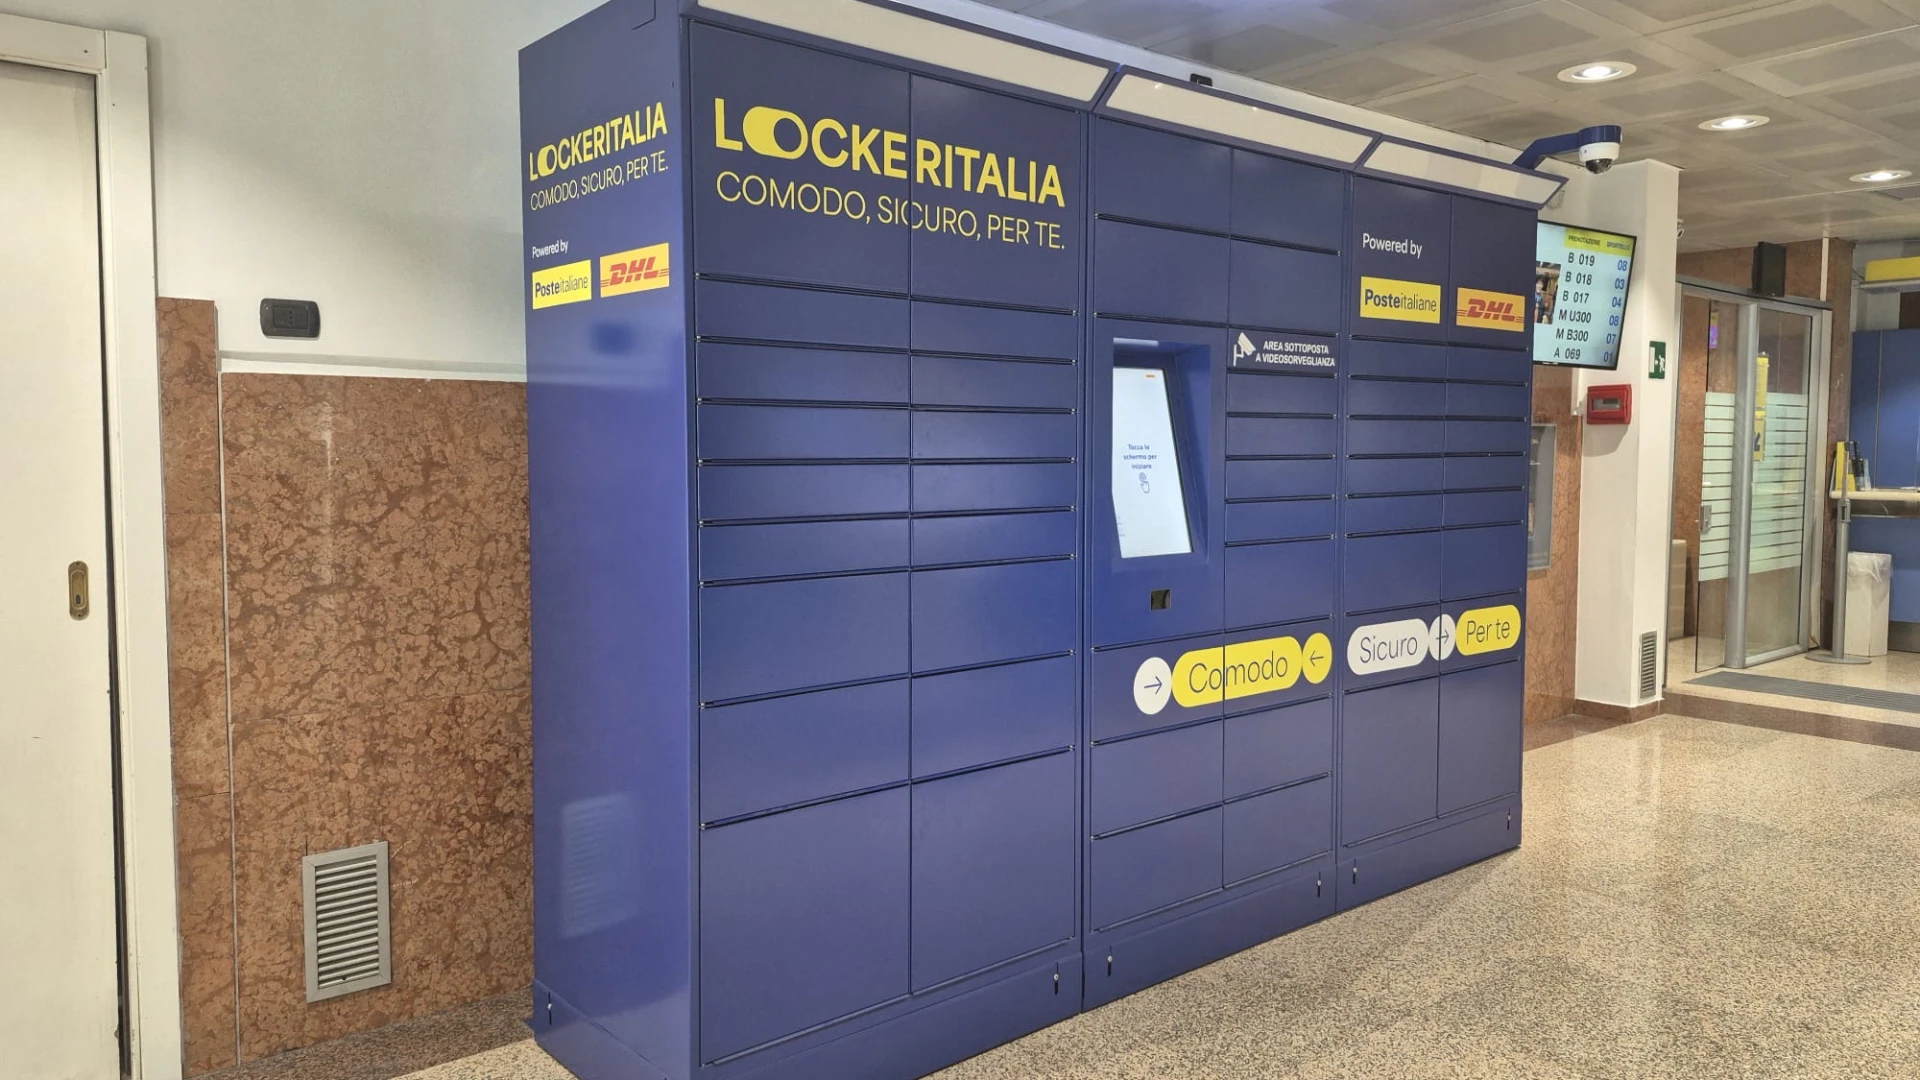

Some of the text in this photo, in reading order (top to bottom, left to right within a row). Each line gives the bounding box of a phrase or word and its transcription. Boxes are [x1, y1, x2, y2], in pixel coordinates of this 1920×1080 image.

[529, 102, 668, 181] LOCKERITALIA
[714, 97, 1066, 208] LOCKERITALIA
[530, 150, 669, 211] COMODO, SICURO, PER TE.
[715, 170, 1066, 250] COMODO, SICURO, PER TE.
[532, 239, 569, 259] Powered by
[1362, 232, 1423, 259] Powered by
[609, 256, 659, 286] DHL
[1568, 252, 1628, 271] B 019 08
[535, 276, 589, 298] Posteitaliane
[1565, 271, 1625, 290] B 018 03
[1364, 288, 1437, 313] Posteitaliane
[1466, 298, 1516, 322] DHL
[1562, 290, 1622, 308] B 017 04
[1558, 309, 1567, 320] M
[1569, 310, 1591, 323] U300
[1263, 340, 1329, 354] AREA SOTTOPOSTA
[1556, 328, 1616, 345] M B300 07
[1255, 352, 1336, 367] A VIDEOSORVEGLIANZA
[1554, 347, 1613, 363] A 069 01
[1466, 616, 1511, 645] Per te
[1359, 634, 1419, 665] Sicuro
[1188, 650, 1288, 694] Comodo
